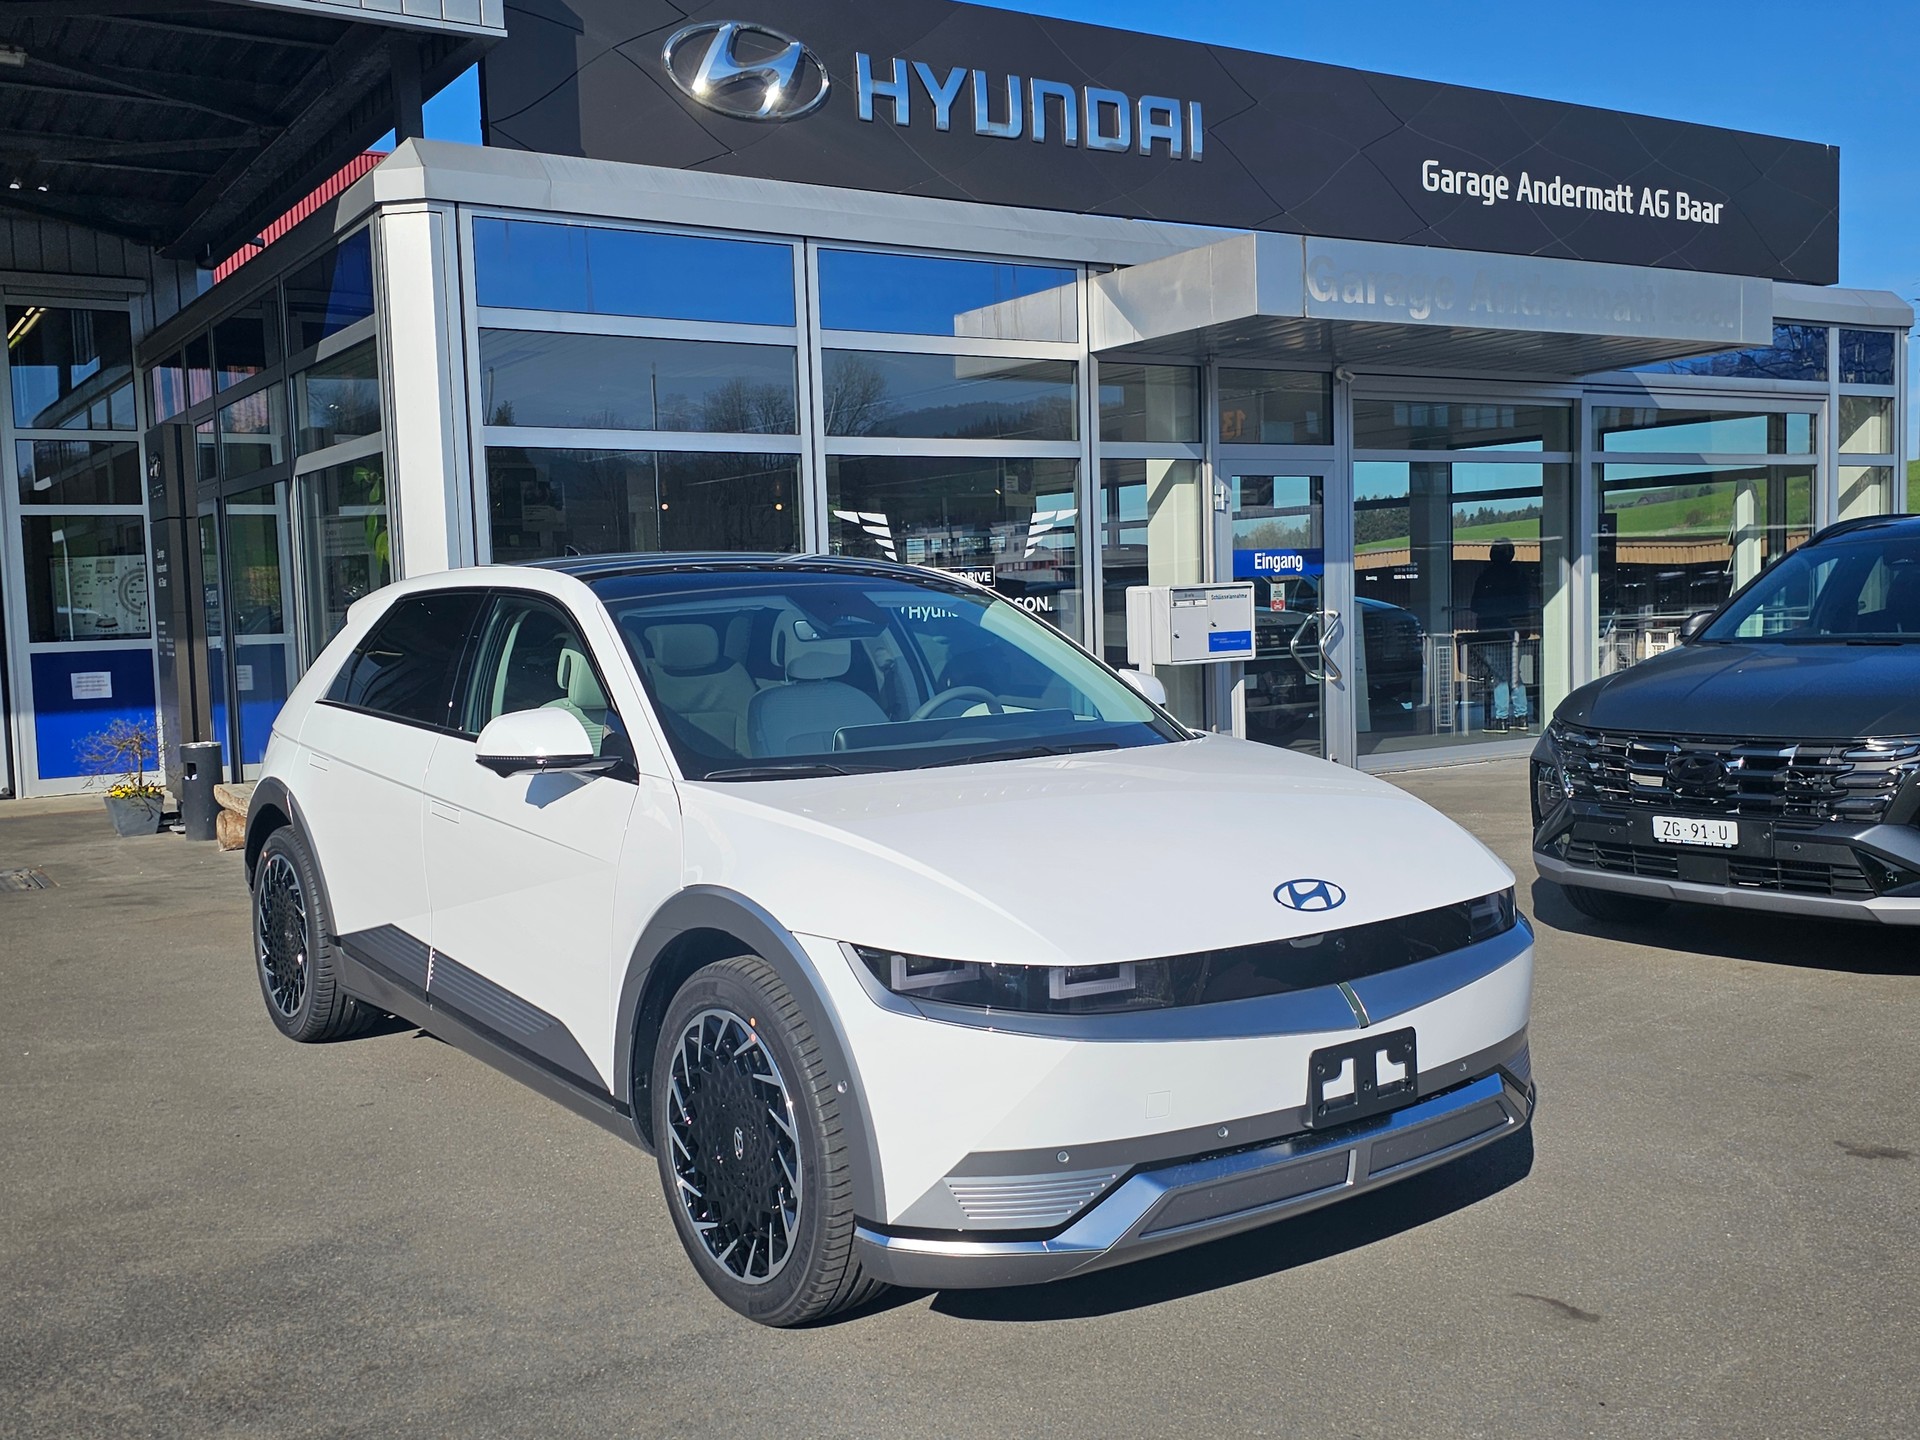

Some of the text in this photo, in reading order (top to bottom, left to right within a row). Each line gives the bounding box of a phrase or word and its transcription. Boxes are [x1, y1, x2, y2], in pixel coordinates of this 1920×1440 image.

[855, 51, 1204, 162] HYUNDAI
[1422, 160, 1724, 224] Garage Andermatt AG Baar
[1306, 254, 1456, 320] Garage
[1254, 552, 1303, 572] Eingang
